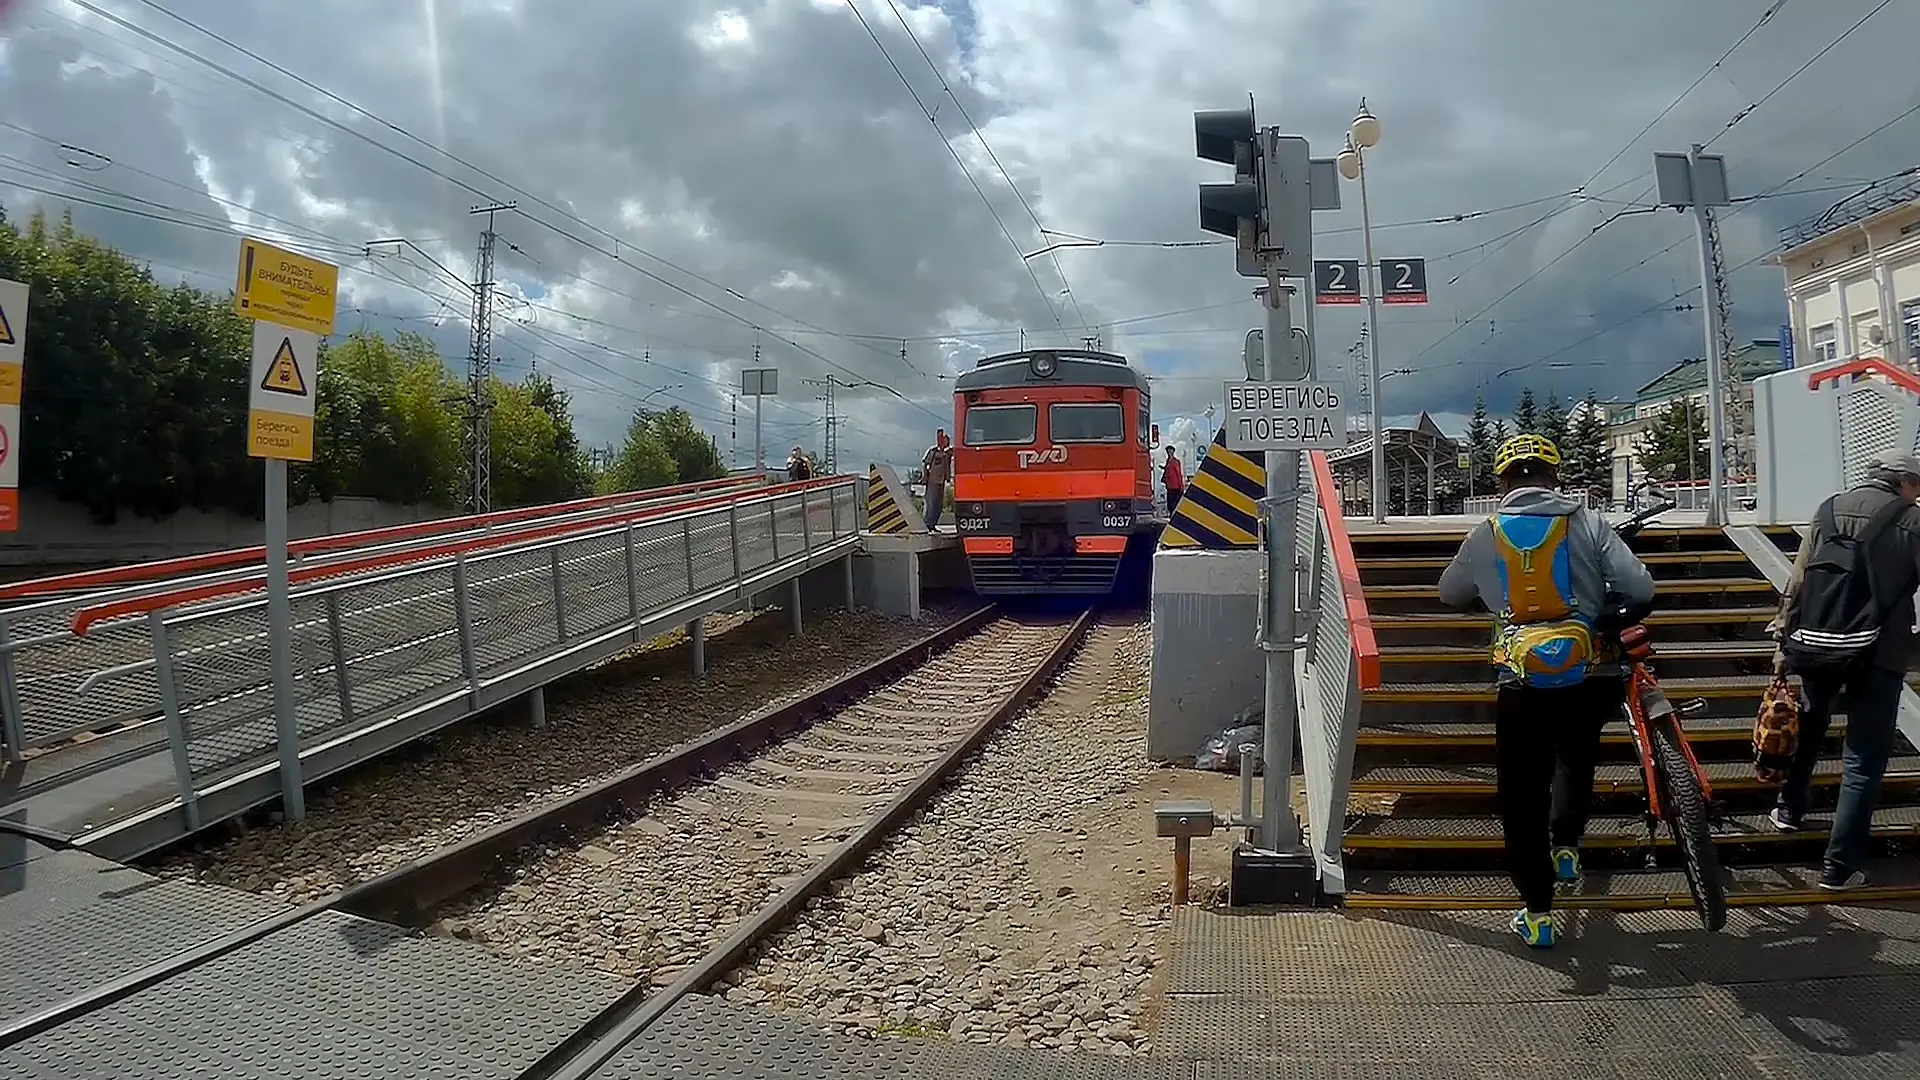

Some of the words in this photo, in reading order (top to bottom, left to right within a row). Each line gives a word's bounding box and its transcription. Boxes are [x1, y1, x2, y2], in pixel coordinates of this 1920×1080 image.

[280, 260, 314, 280] БУДЬТЕ
[1329, 264, 1347, 290] 2
[1395, 263, 1413, 289] 2
[1230, 386, 1339, 410] БЕРЕГИСЬ
[1239, 416, 1334, 442] ПОЕЗДА
[1017, 445, 1068, 469] РЖД
[959, 517, 991, 531] ЭД2Т
[1103, 515, 1132, 528] 0037
